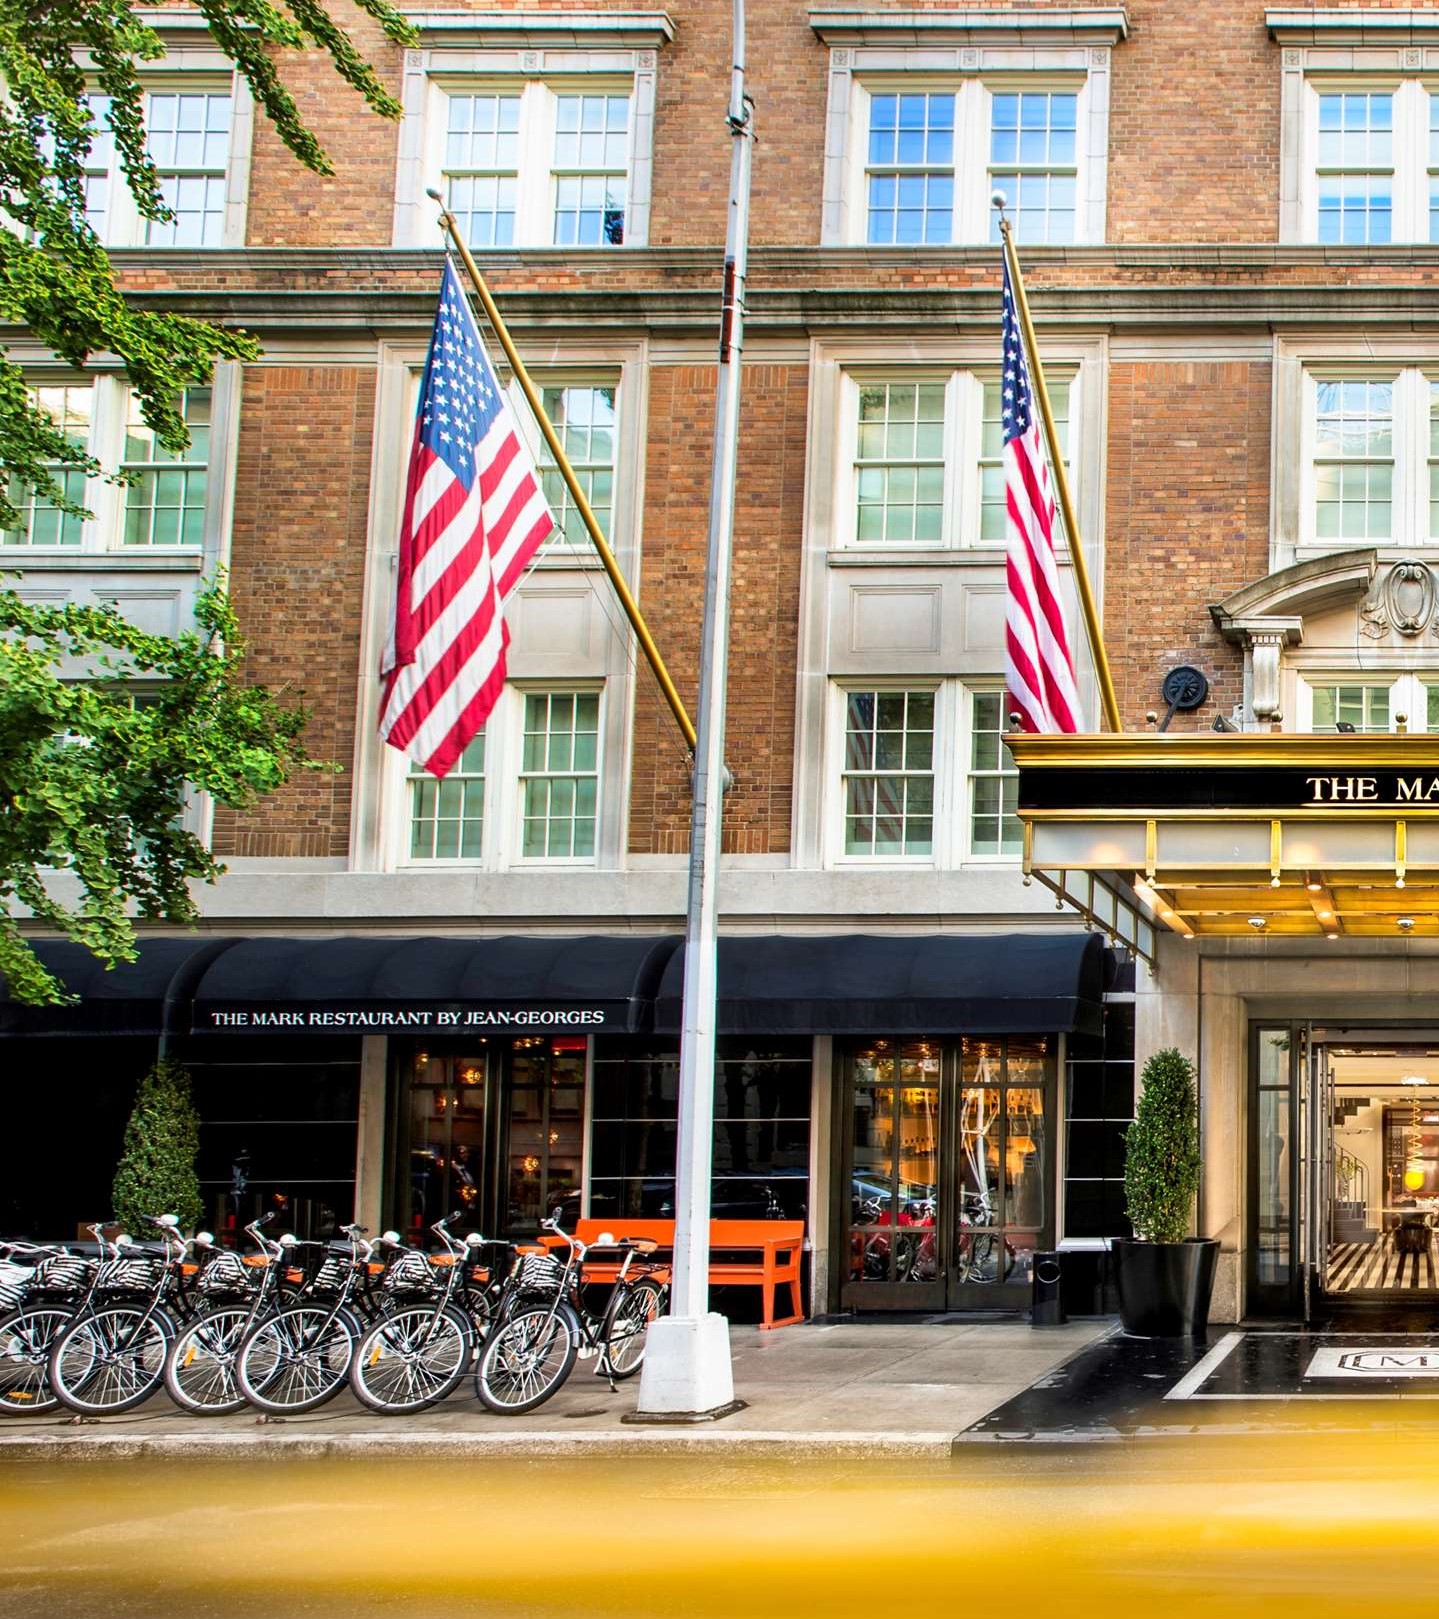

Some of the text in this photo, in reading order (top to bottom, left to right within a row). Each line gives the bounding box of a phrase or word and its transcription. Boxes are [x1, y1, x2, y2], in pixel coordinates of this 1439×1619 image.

[1306, 778, 1379, 800] THE
[211, 1010, 605, 1025] THE MARK RESTAURANT BY JEAN-GEORGES
